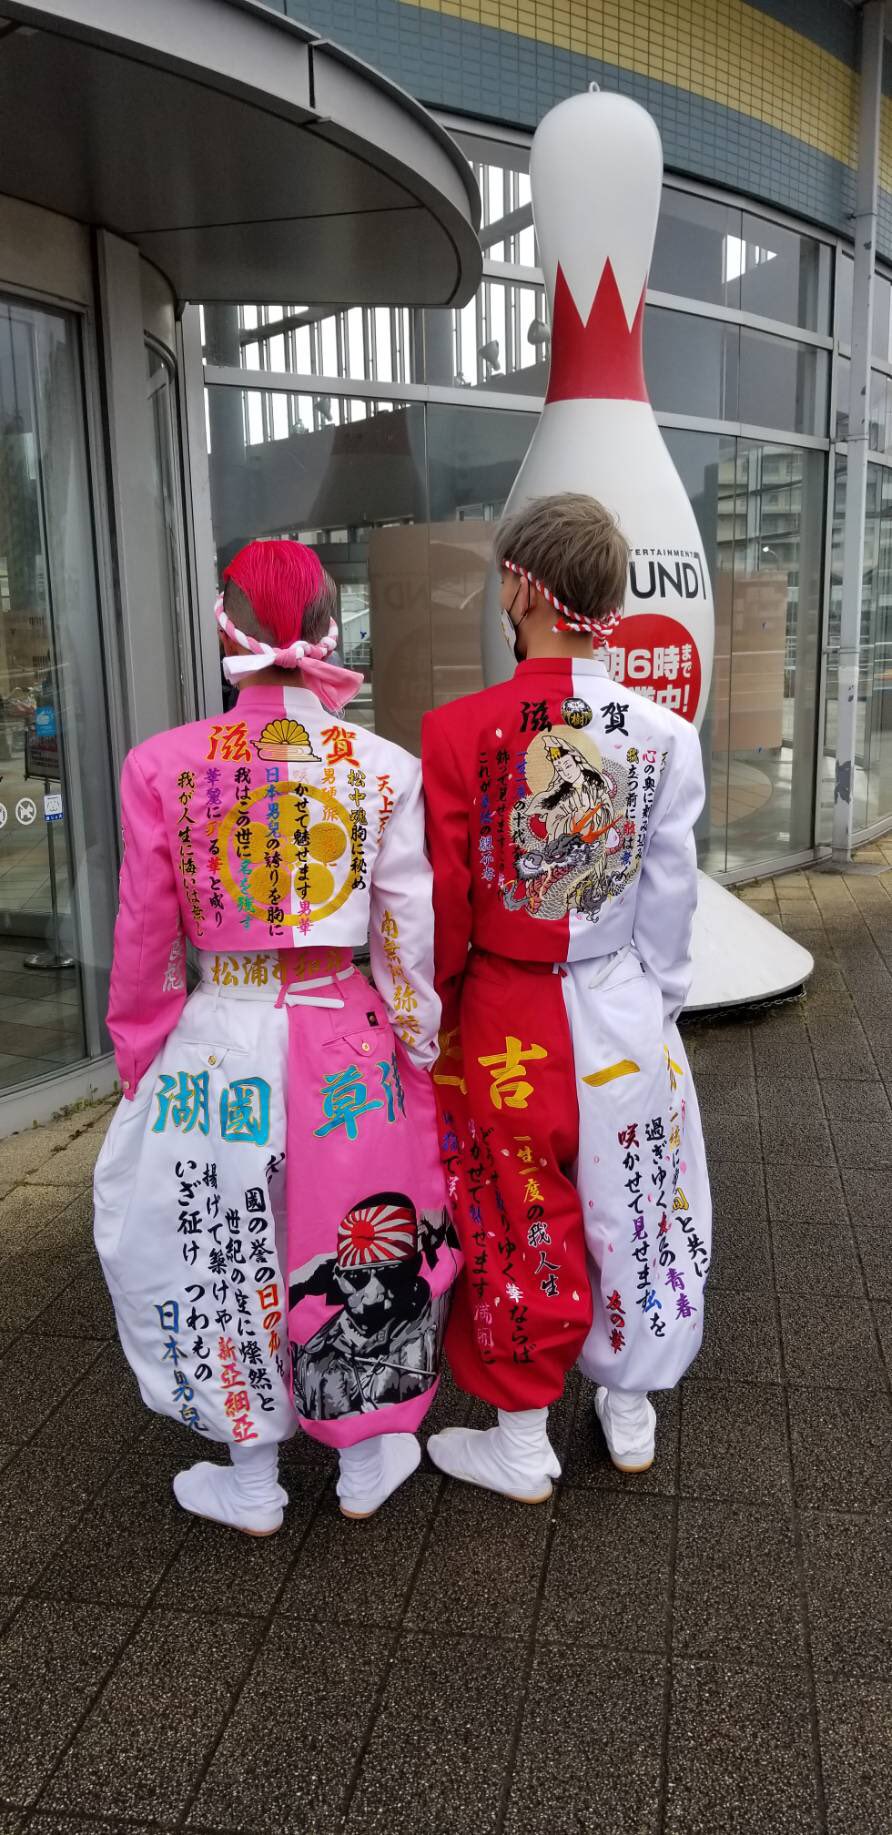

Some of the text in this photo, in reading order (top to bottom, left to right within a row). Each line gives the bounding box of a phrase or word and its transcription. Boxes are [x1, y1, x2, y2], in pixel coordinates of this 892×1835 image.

[512, 1134, 561, 1299] 一生一度の我人生
